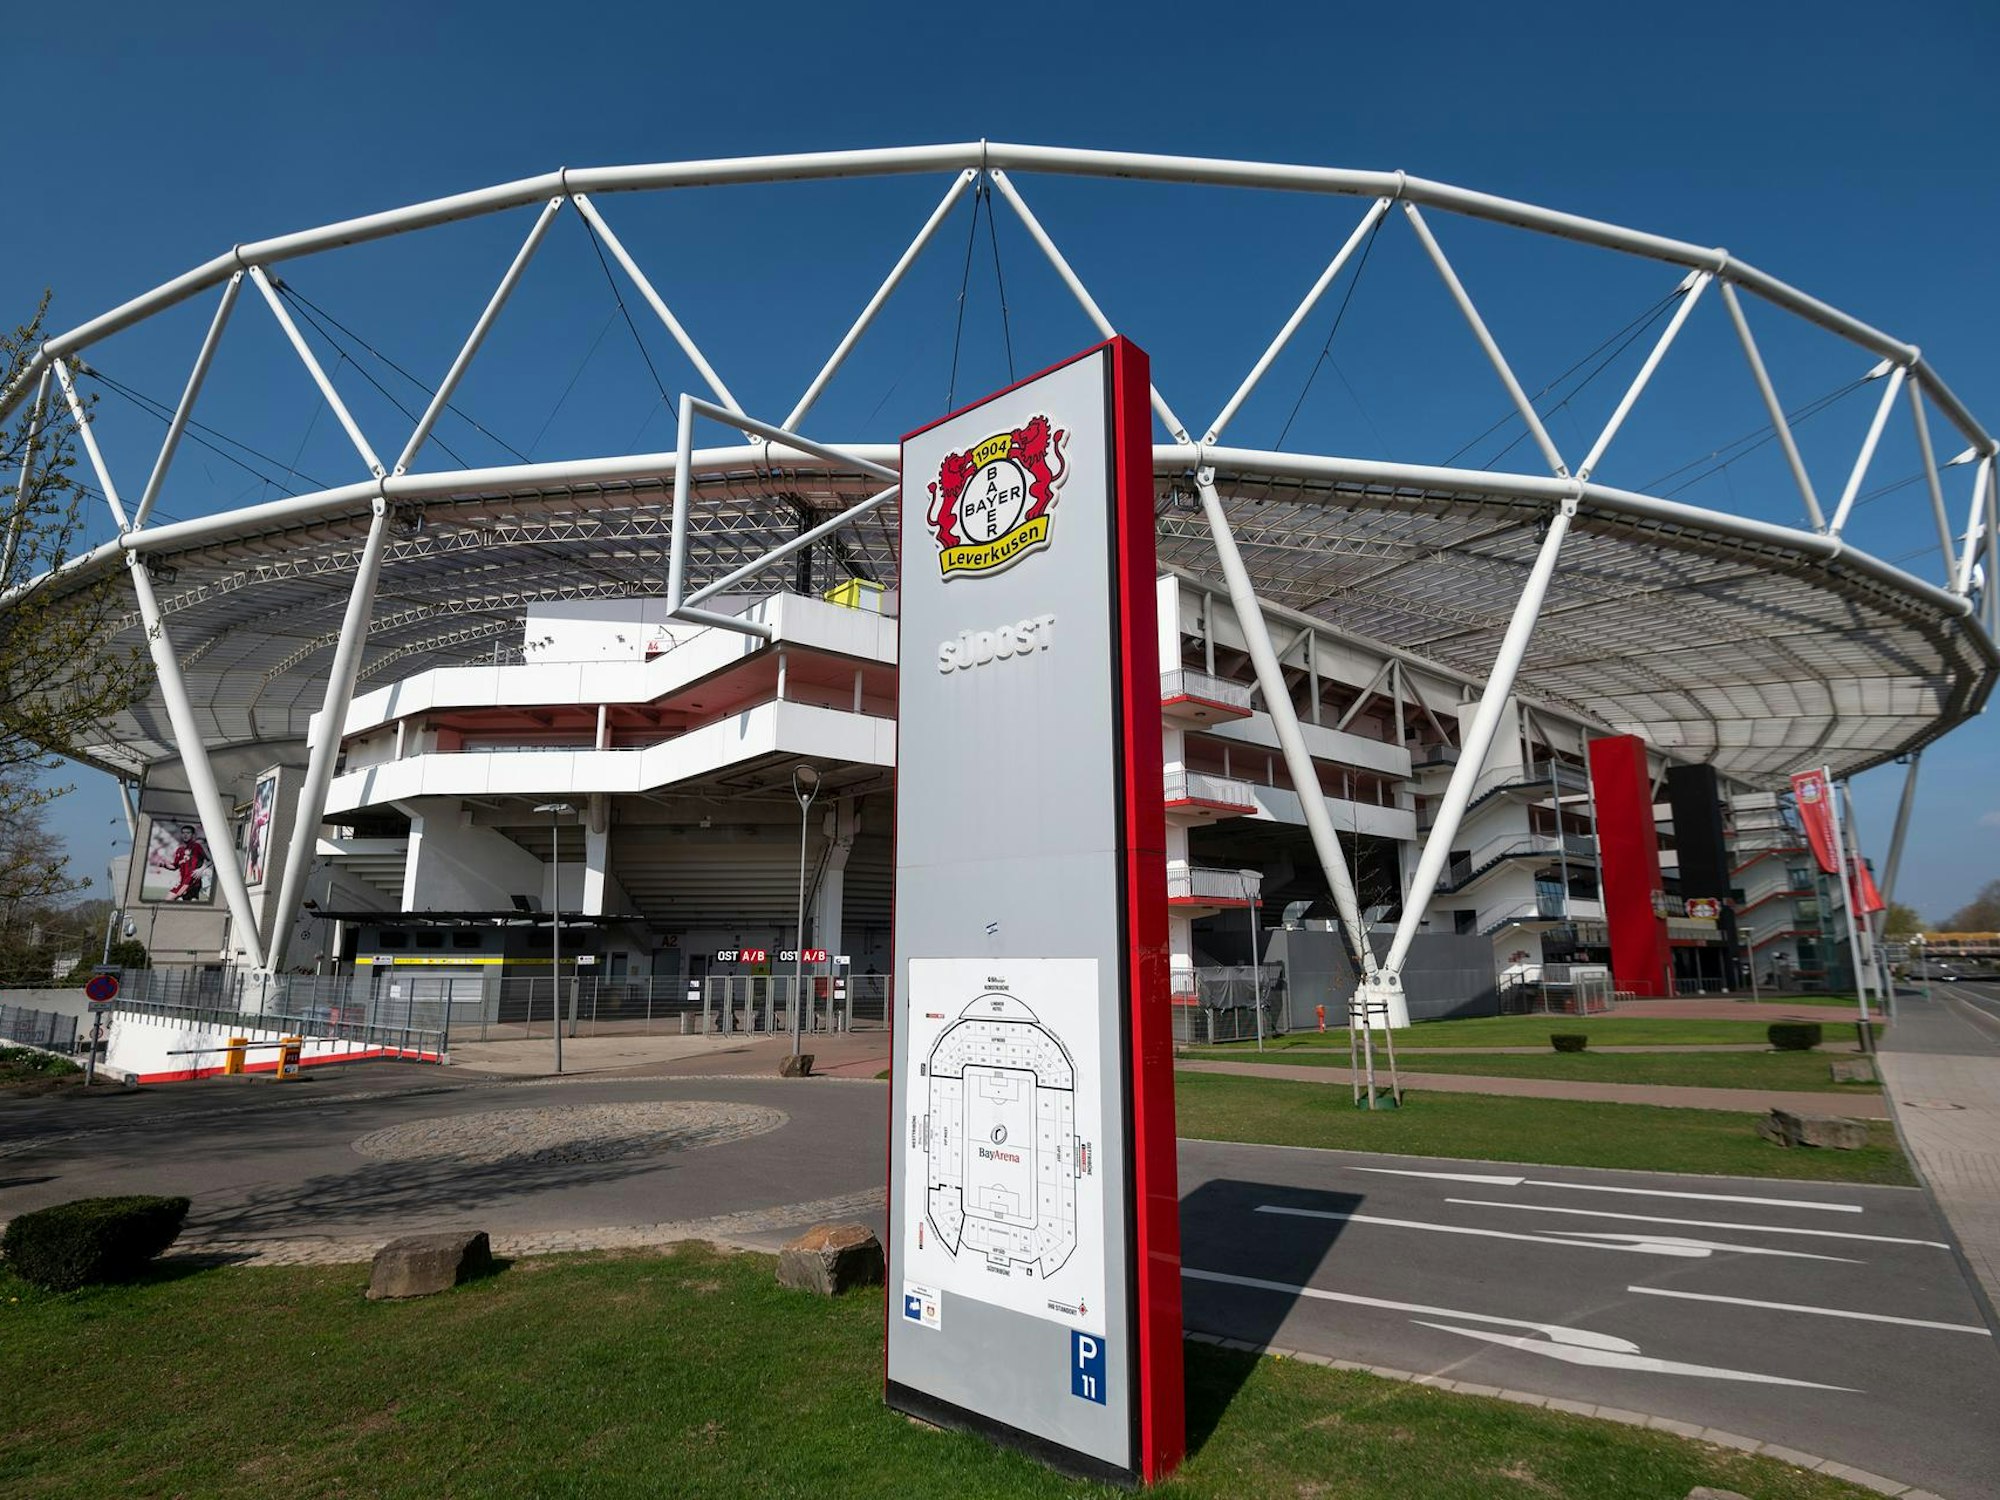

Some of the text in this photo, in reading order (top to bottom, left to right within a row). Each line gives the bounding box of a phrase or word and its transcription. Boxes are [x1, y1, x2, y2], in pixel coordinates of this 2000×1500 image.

[975, 439, 1008, 463] 1904
[965, 486, 1021, 518] BAYER
[986, 466, 998, 538] BAYER
[947, 525, 1039, 567] Leverkusen
[938, 613, 1056, 674] SÜDOST
[661, 935, 678, 947] A2
[717, 950, 765, 961] OST A/B
[803, 950, 826, 961] A/B
[978, 1147, 1020, 1163] BayArena
[1078, 1334, 1098, 1369] P
[1081, 1373, 1096, 1399] 11
